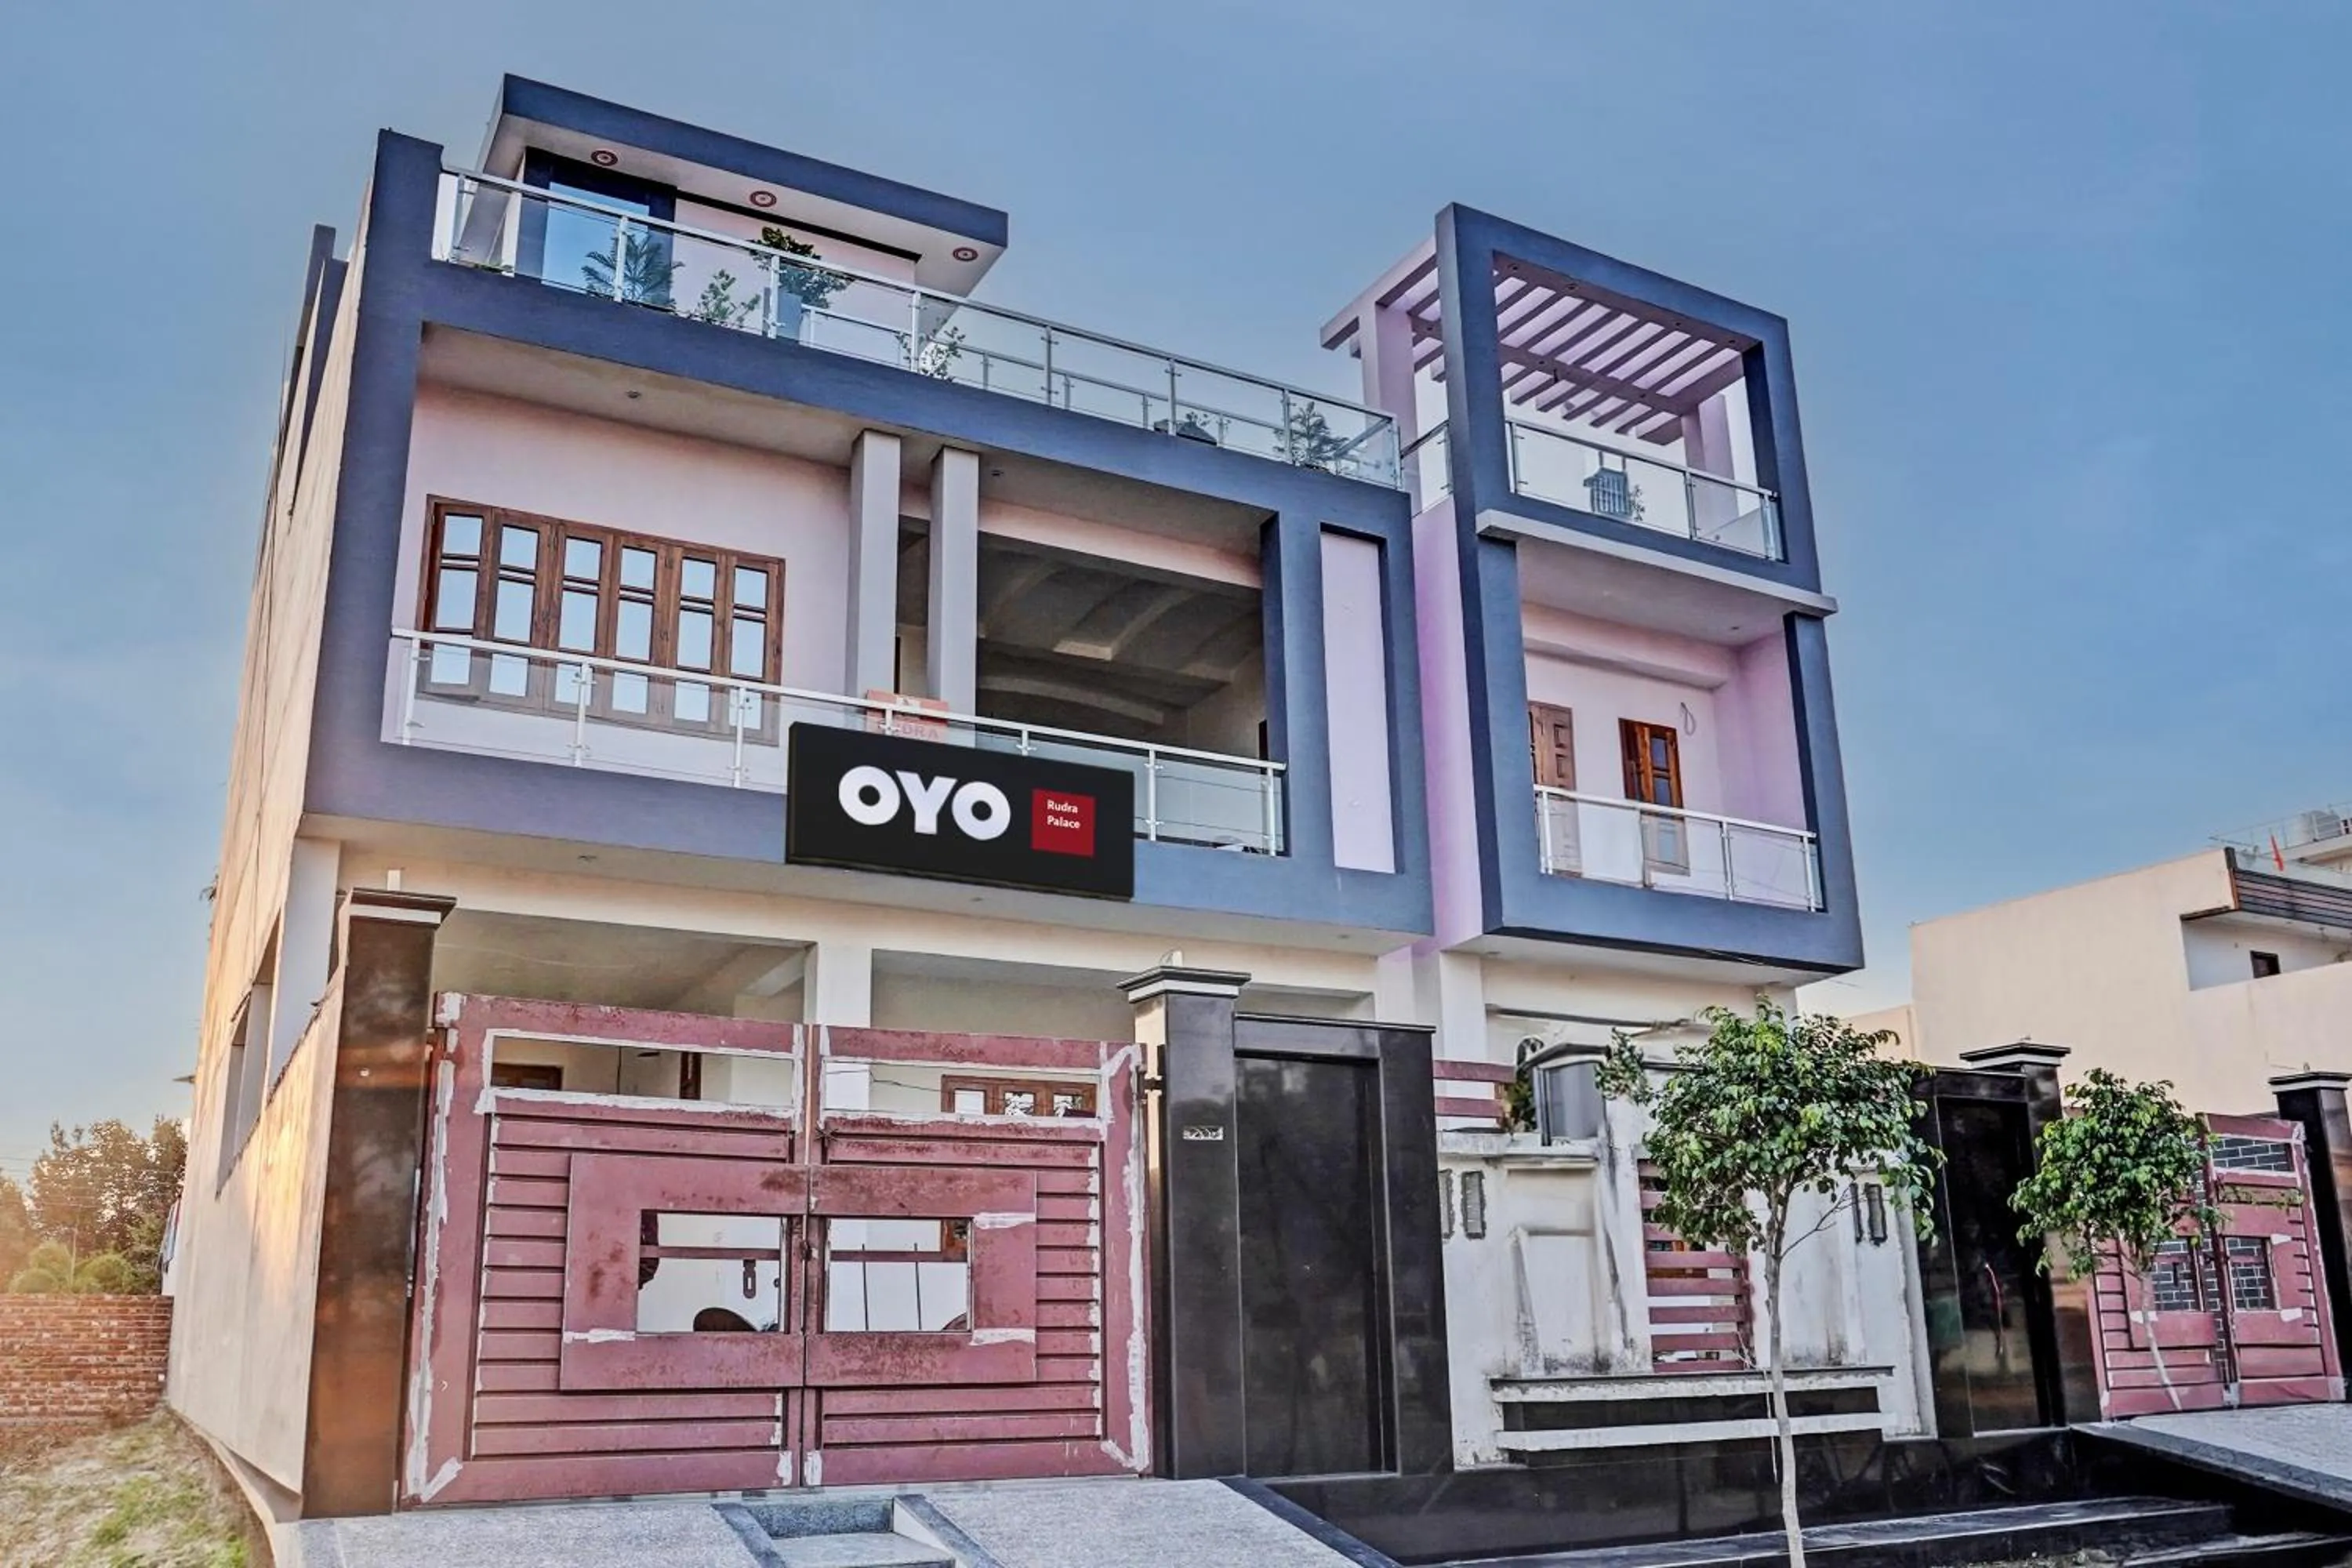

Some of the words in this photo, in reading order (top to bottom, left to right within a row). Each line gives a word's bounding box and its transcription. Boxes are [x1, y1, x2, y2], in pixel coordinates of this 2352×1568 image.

[839, 765, 1011, 840] OYO
[1047, 799, 1078, 814] Rudra
[1047, 815, 1081, 829] Palace
